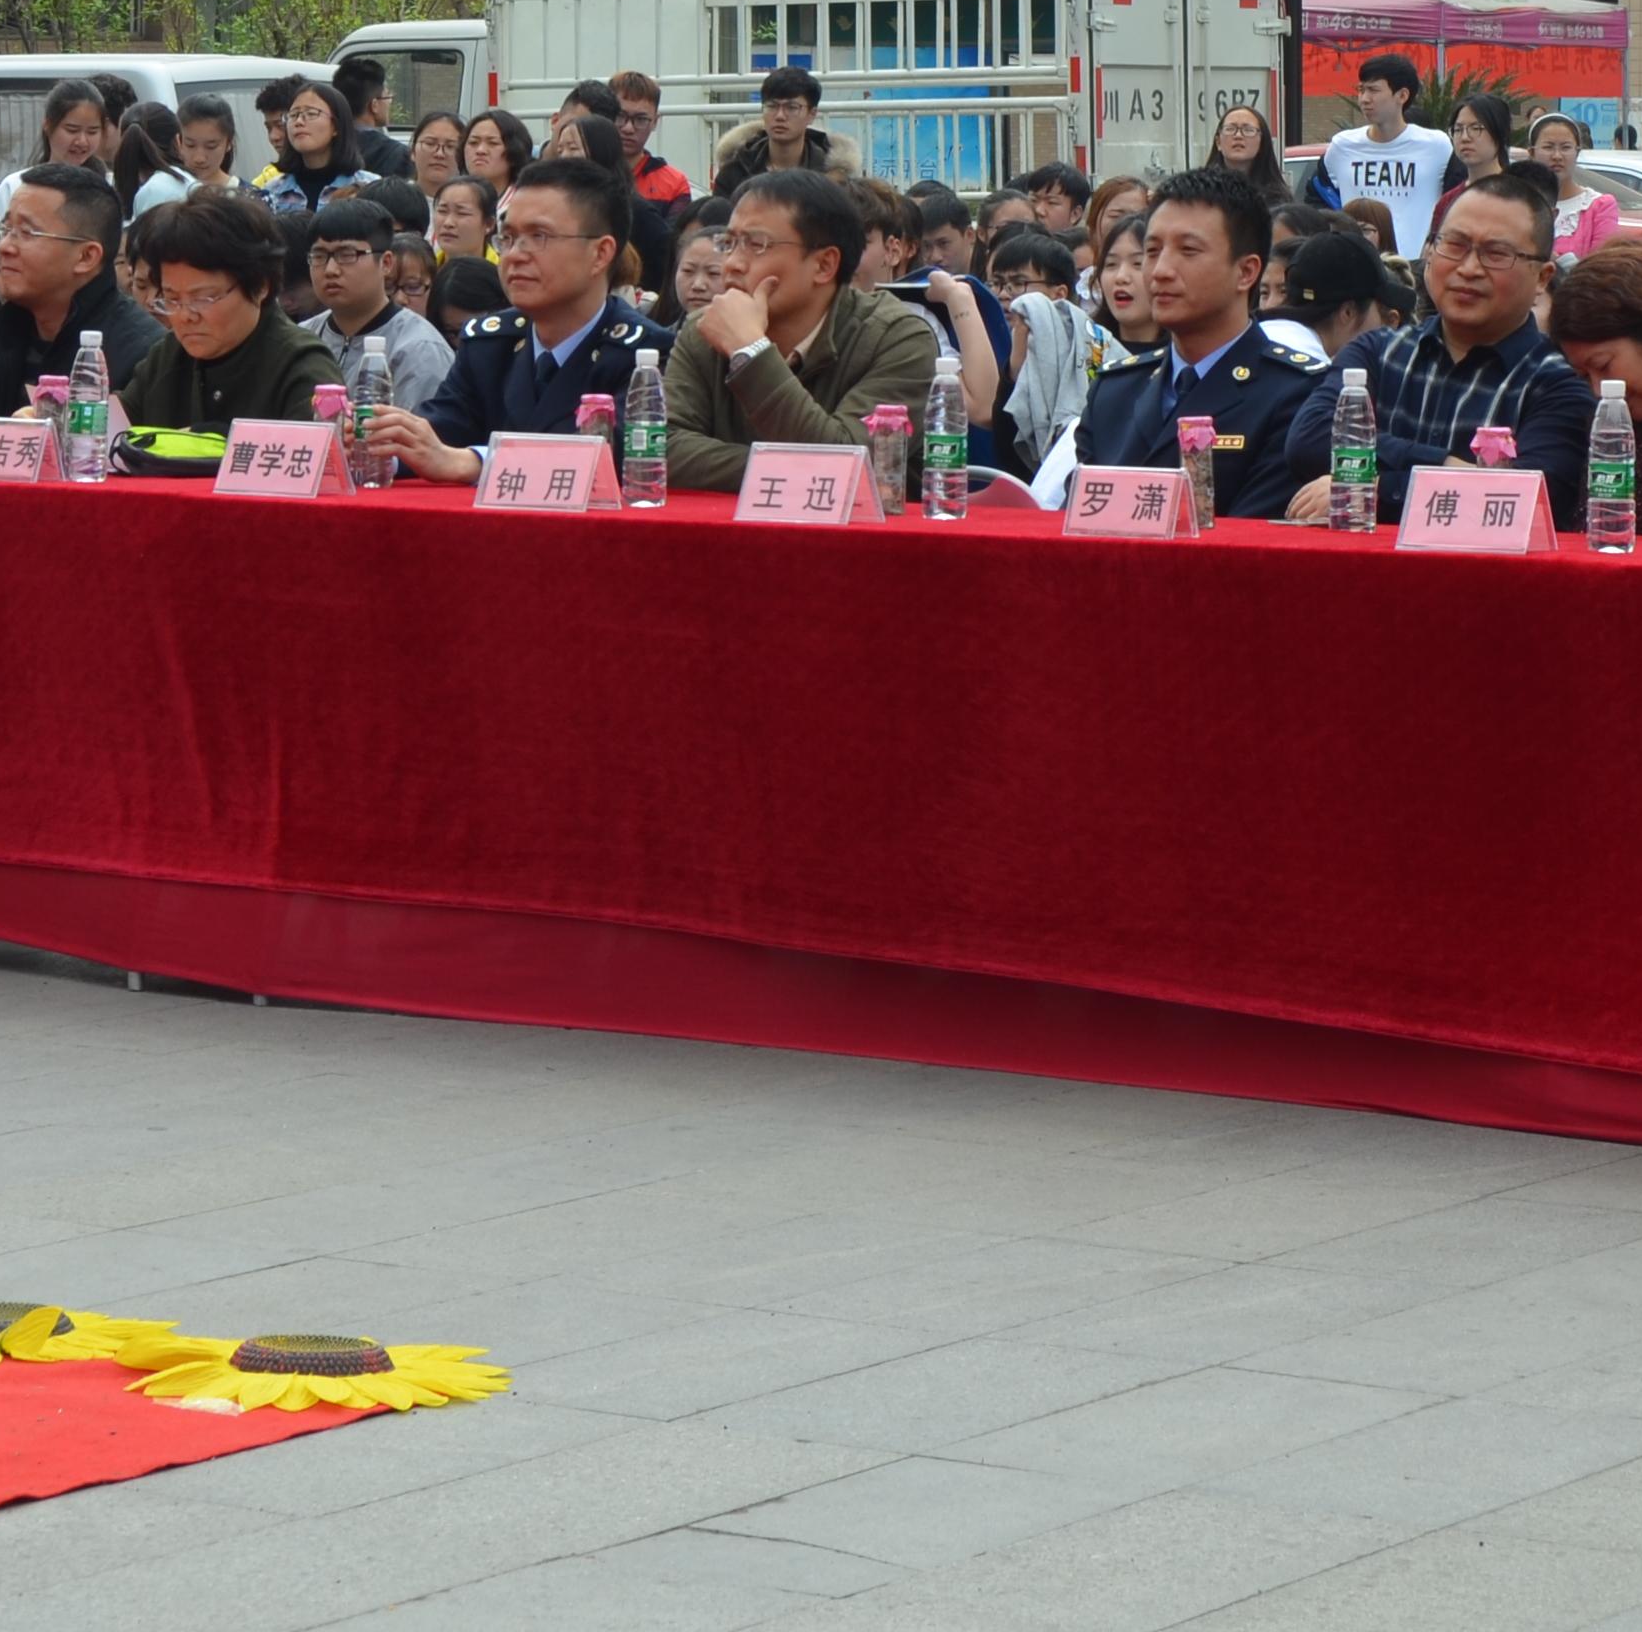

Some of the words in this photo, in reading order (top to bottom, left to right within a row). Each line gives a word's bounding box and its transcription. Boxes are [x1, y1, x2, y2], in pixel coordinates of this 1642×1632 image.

[1351, 161, 1415, 188] TEAM
[228, 440, 314, 479] 曹学忠
[496, 467, 578, 503] 钟用
[752, 476, 837, 513] 王迅
[1078, 480, 1168, 522] 罗潇
[1424, 490, 1521, 528] 傅丽
